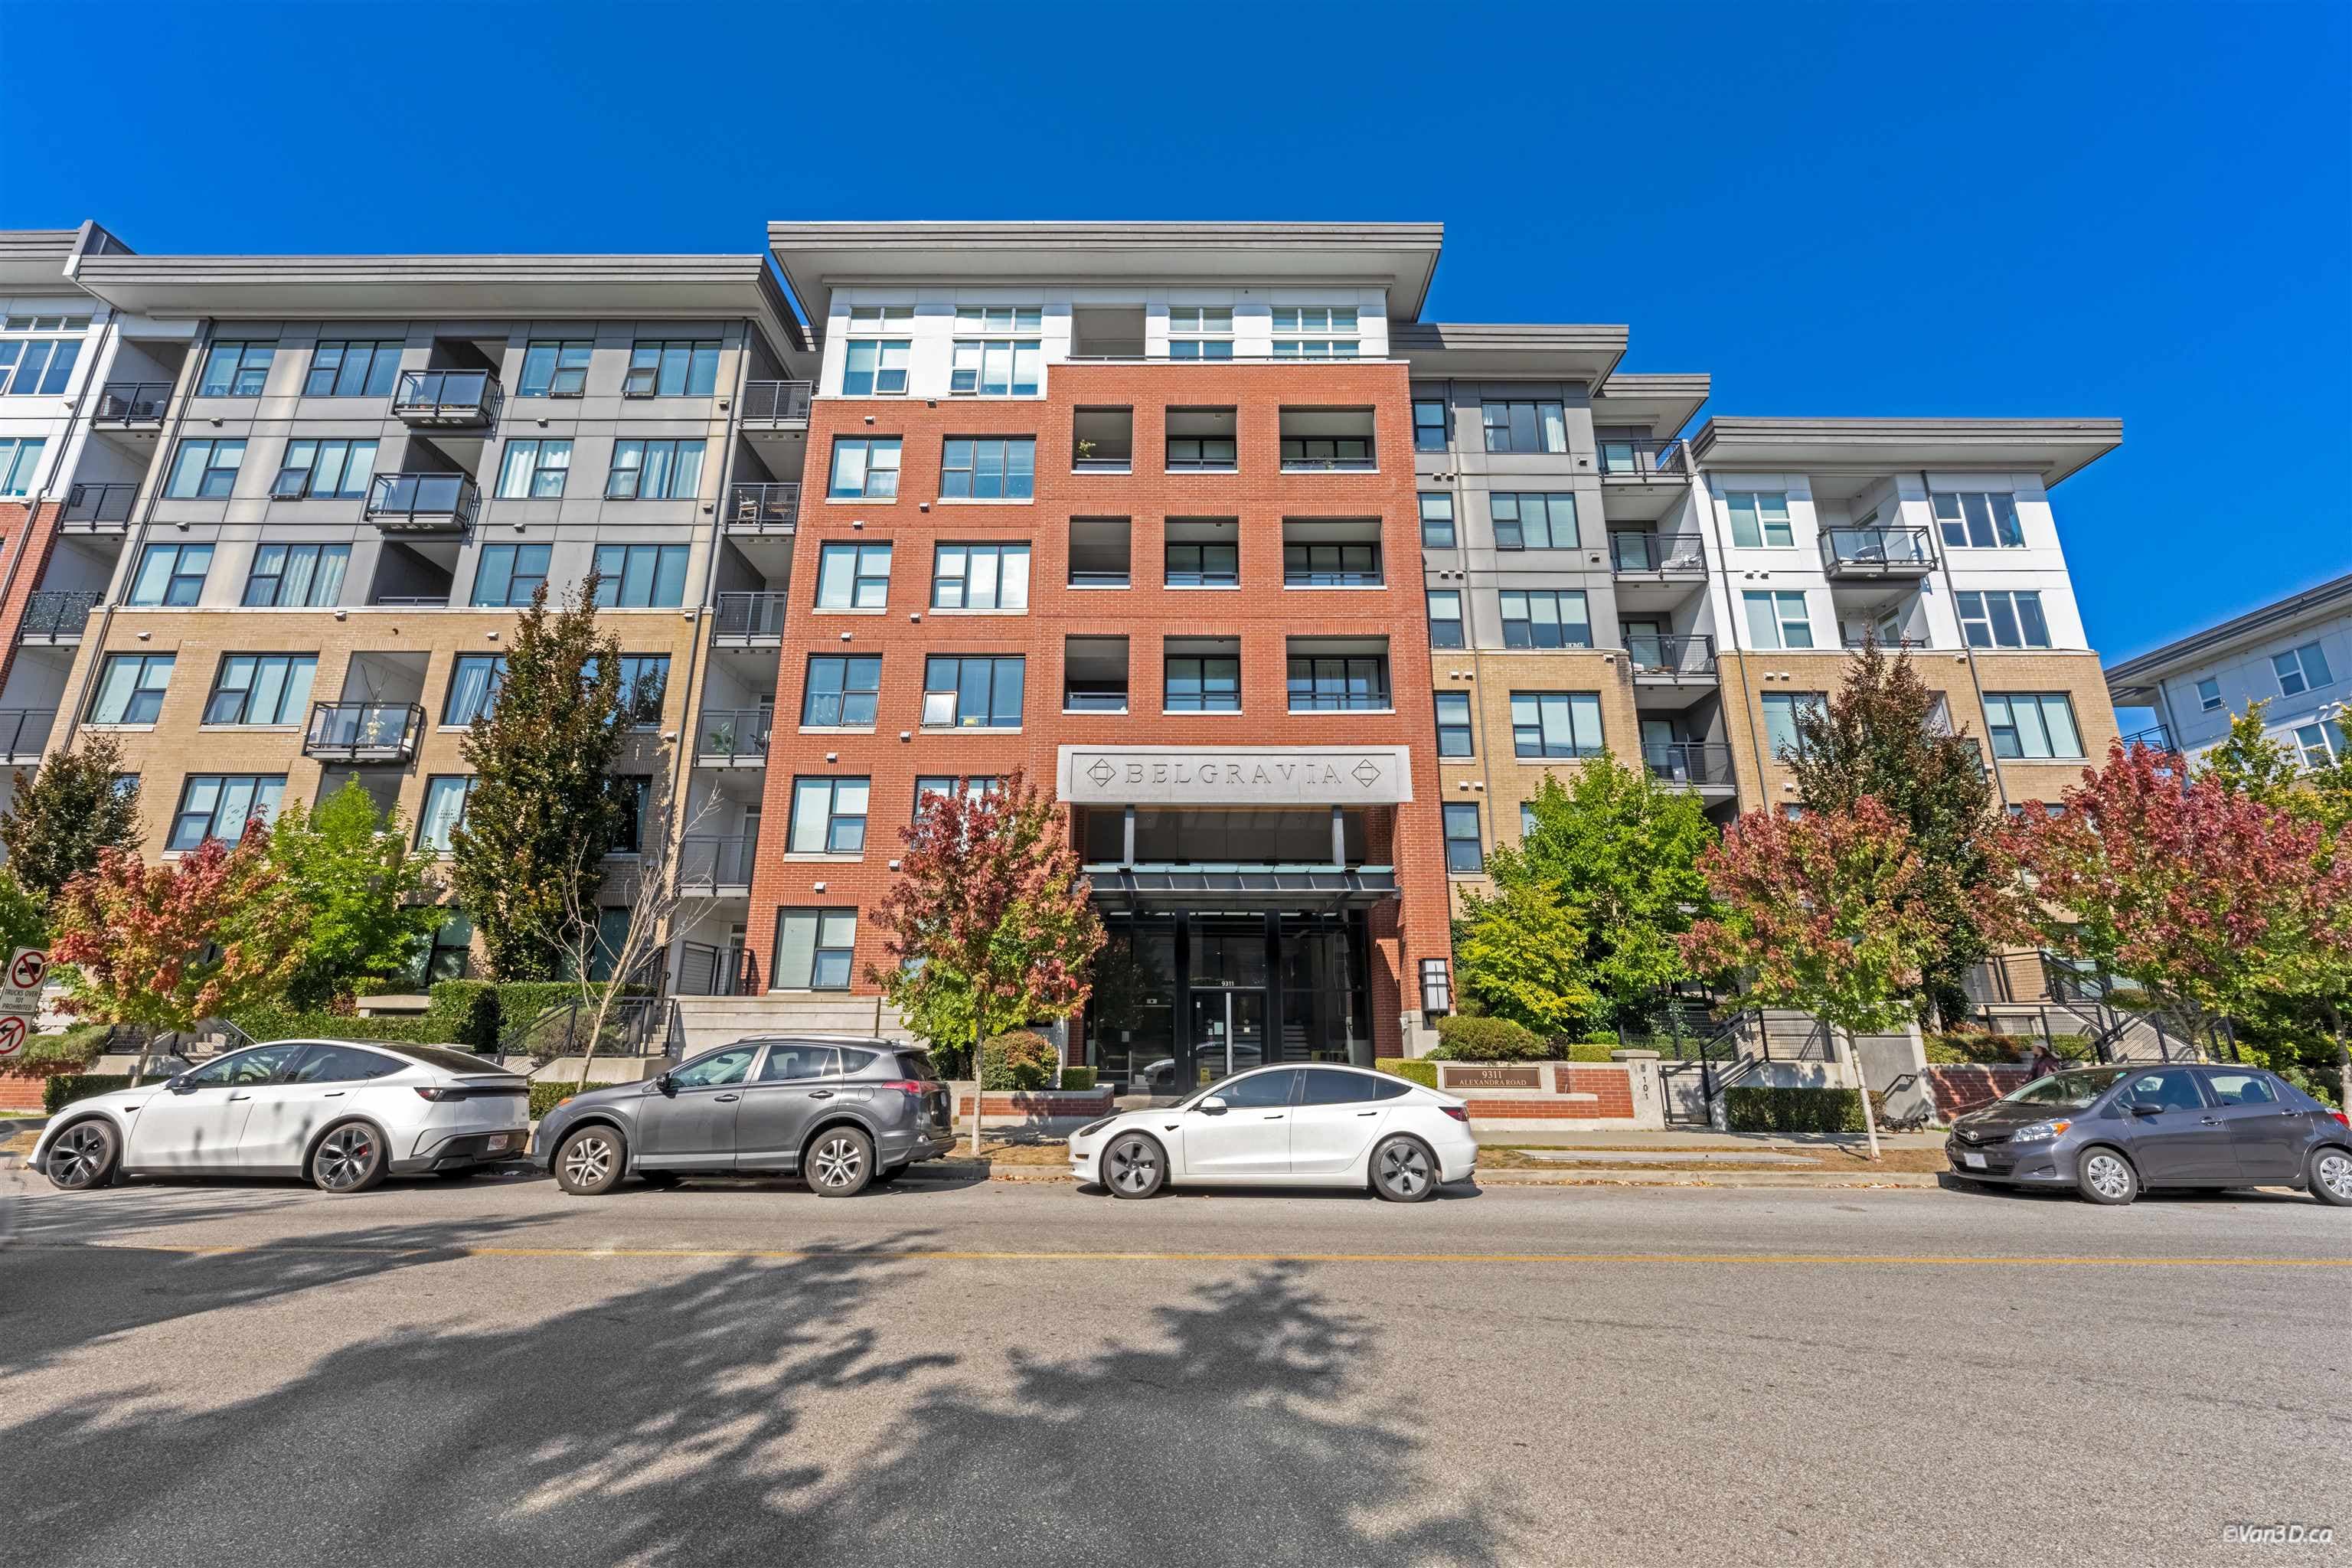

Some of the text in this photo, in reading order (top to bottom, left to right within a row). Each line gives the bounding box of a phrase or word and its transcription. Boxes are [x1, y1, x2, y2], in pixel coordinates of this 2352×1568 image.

[1124, 763, 1342, 785] BELGRAVIA
[2, 1003, 32, 1011] PROHIBITED
[1481, 1070, 1502, 1079] 9311
